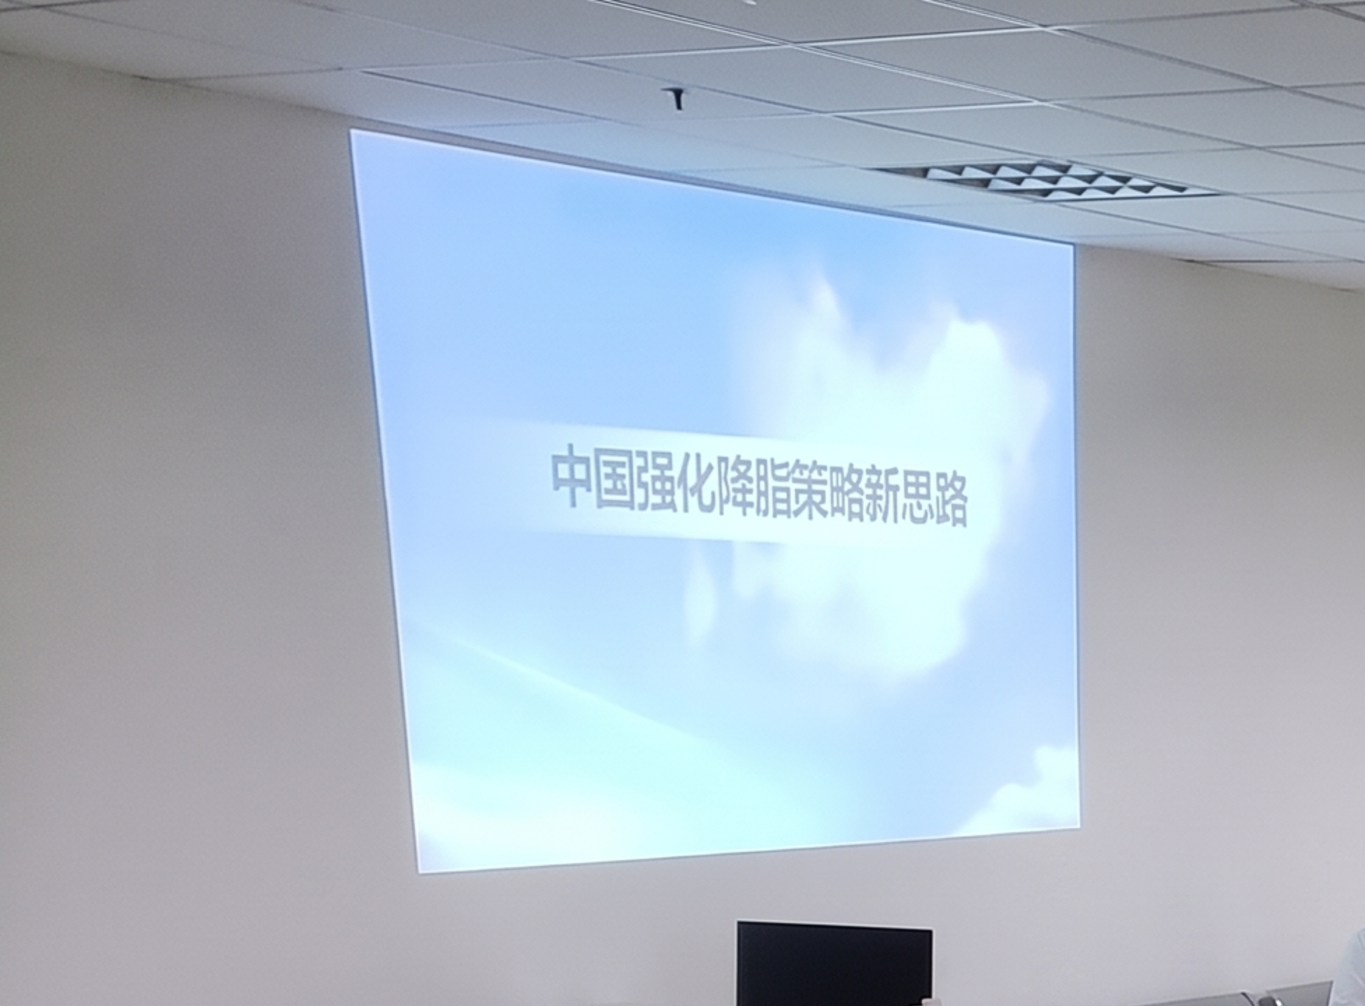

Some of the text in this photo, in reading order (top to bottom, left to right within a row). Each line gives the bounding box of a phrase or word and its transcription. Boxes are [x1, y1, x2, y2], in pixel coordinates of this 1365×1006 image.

[550, 442, 969, 528] 中国强化降脂策略新思路
